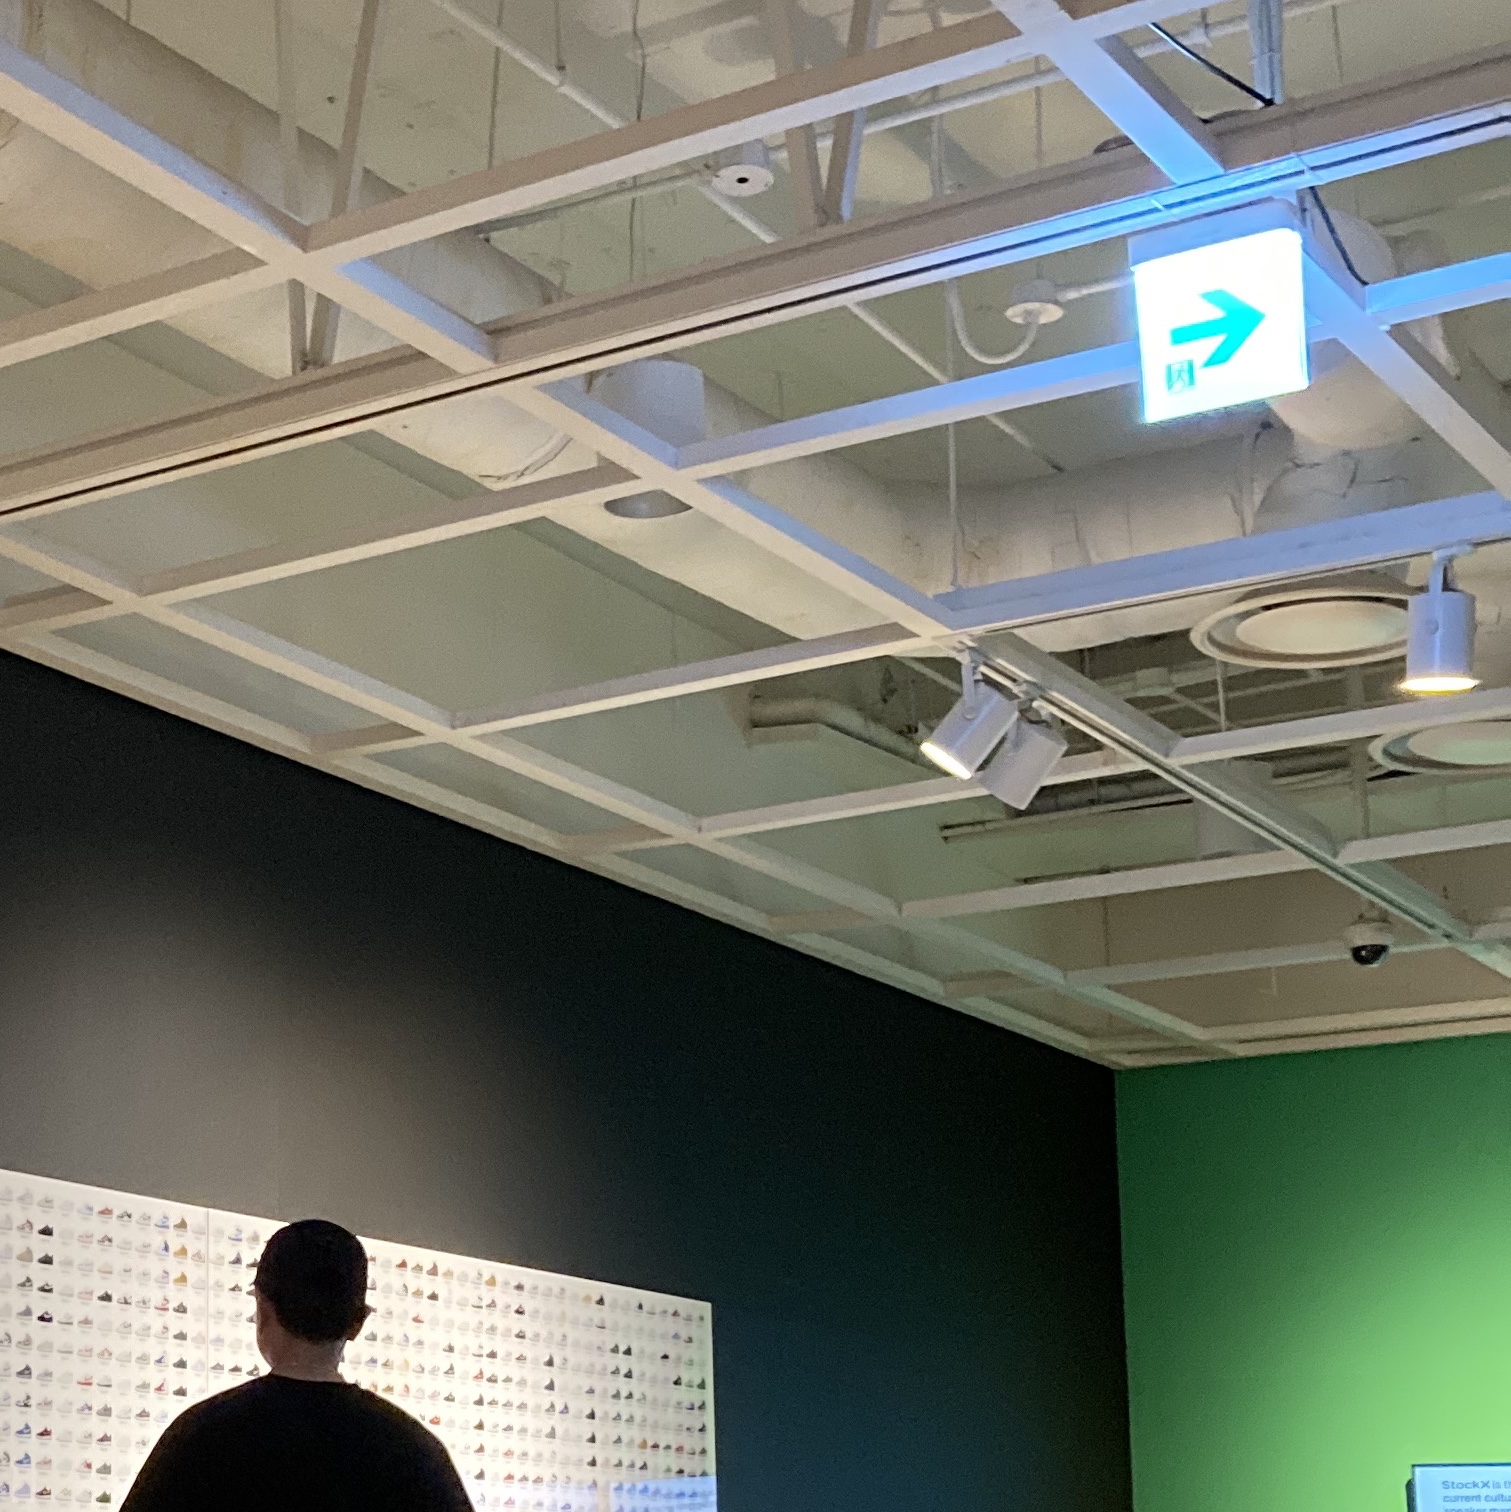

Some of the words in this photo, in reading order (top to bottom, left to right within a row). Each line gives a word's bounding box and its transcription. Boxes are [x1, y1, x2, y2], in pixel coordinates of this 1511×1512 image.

[1442, 1480, 1490, 1490] StockX
[1492, 1480, 1501, 1490] is
[1443, 1494, 1481, 1503] current
